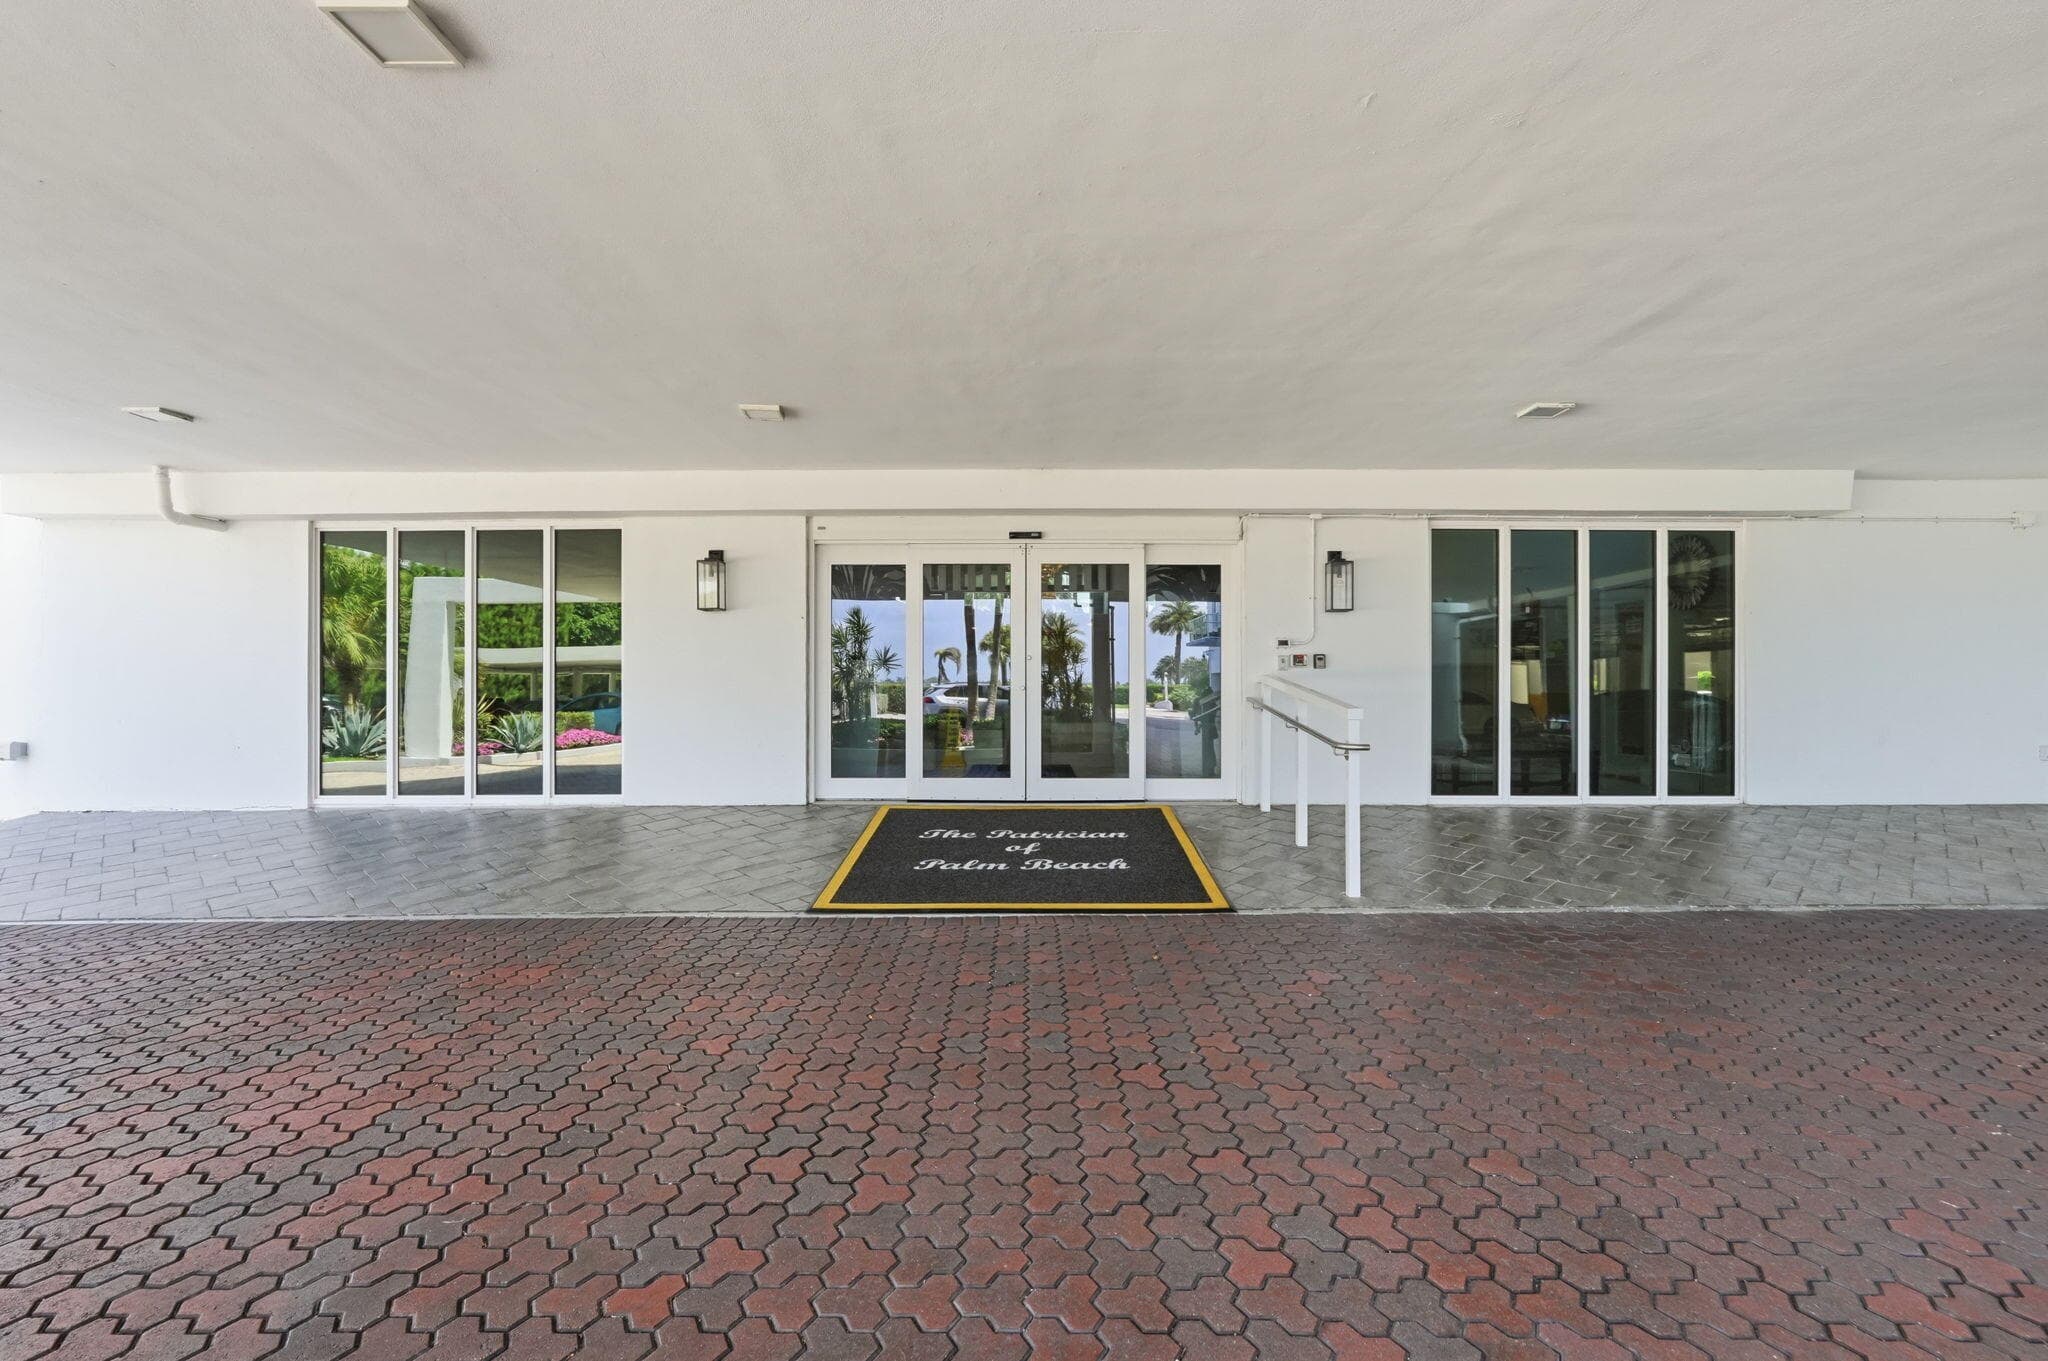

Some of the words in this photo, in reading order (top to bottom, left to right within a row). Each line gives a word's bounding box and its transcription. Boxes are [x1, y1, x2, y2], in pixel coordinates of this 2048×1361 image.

[918, 829, 977, 839] The
[985, 829, 1129, 839] Patrician
[1005, 842, 1041, 855] of
[913, 859, 1010, 870] Palm
[1020, 858, 1131, 870] Beach
